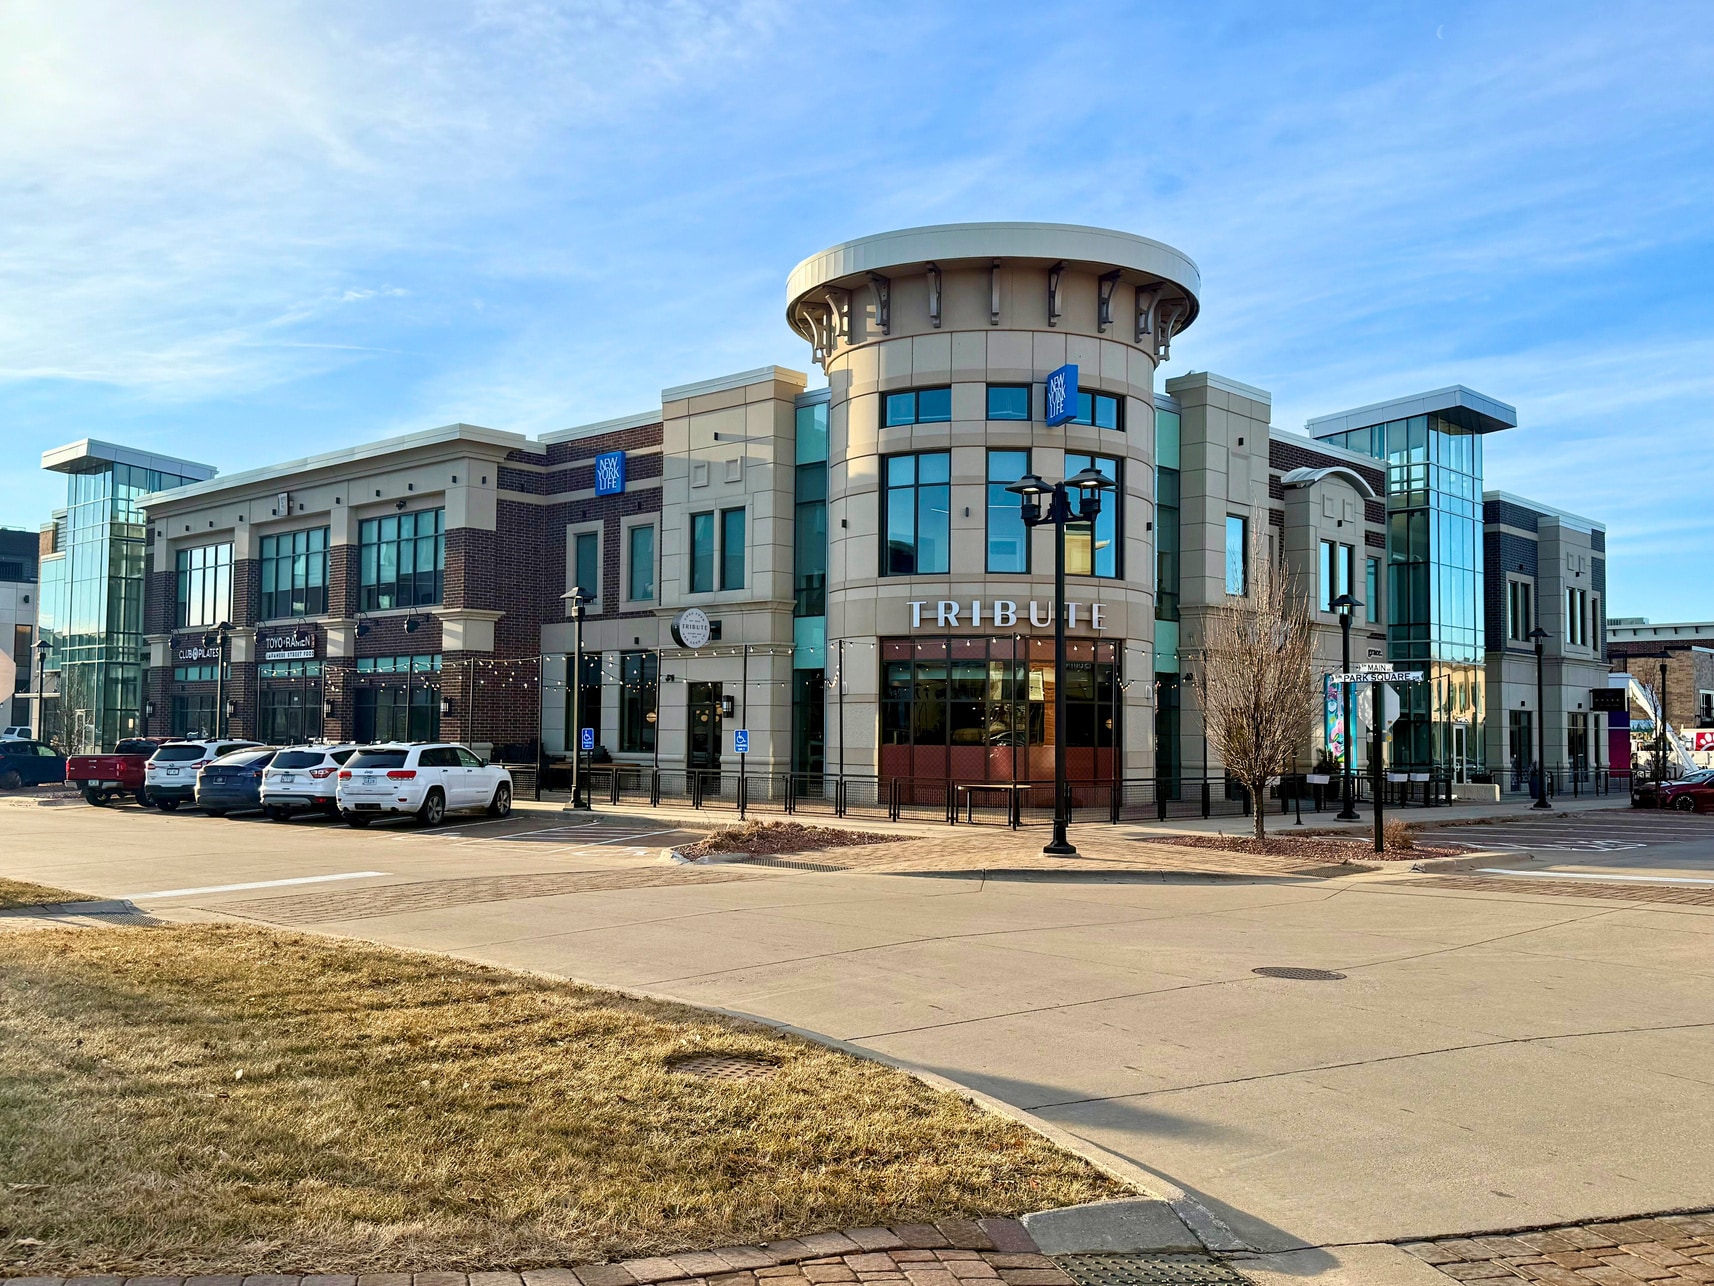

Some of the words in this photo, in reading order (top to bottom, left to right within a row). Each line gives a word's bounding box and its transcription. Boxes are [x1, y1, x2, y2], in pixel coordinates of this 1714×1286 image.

[1050, 372, 1065, 391] NEW
[1048, 384, 1066, 404] YORK
[1050, 399, 1064, 418] LIFE
[600, 457, 618, 470] NEW
[597, 466, 620, 480] YORK
[600, 477, 617, 490] LIFE
[906, 600, 1108, 630] TRIBUTE
[266, 637, 283, 649] TOYO
[178, 649, 193, 660] CLUB
[198, 647, 219, 659] PILATES
[1367, 664, 1386, 672] MAIN
[1343, 674, 1369, 682] PARK
[1370, 672, 1411, 681] SQUARE
